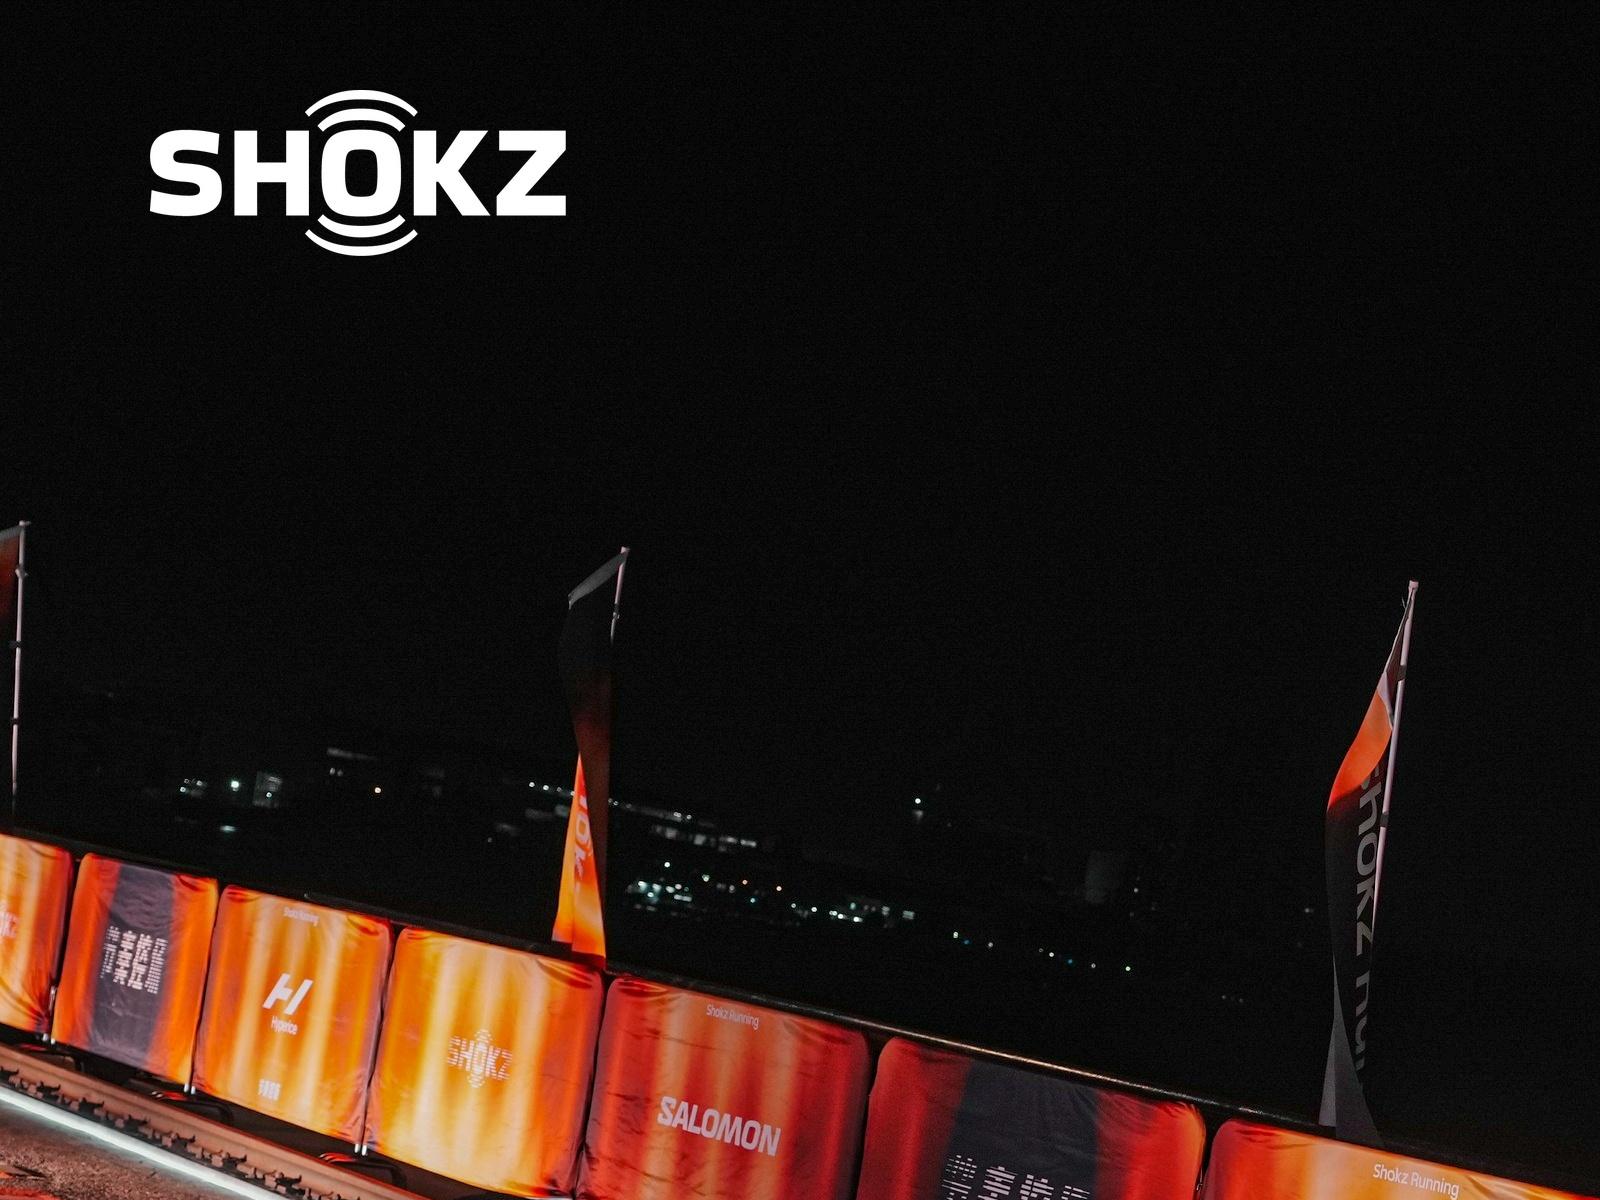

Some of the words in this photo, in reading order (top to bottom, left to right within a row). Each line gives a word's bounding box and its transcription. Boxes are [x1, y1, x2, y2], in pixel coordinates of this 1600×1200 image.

[446, 1035, 514, 1081] SHOKZ
[657, 1095, 782, 1157] SALOMON
[1372, 1163, 1410, 1185] Shokz
[1410, 1171, 1460, 1200] Running
